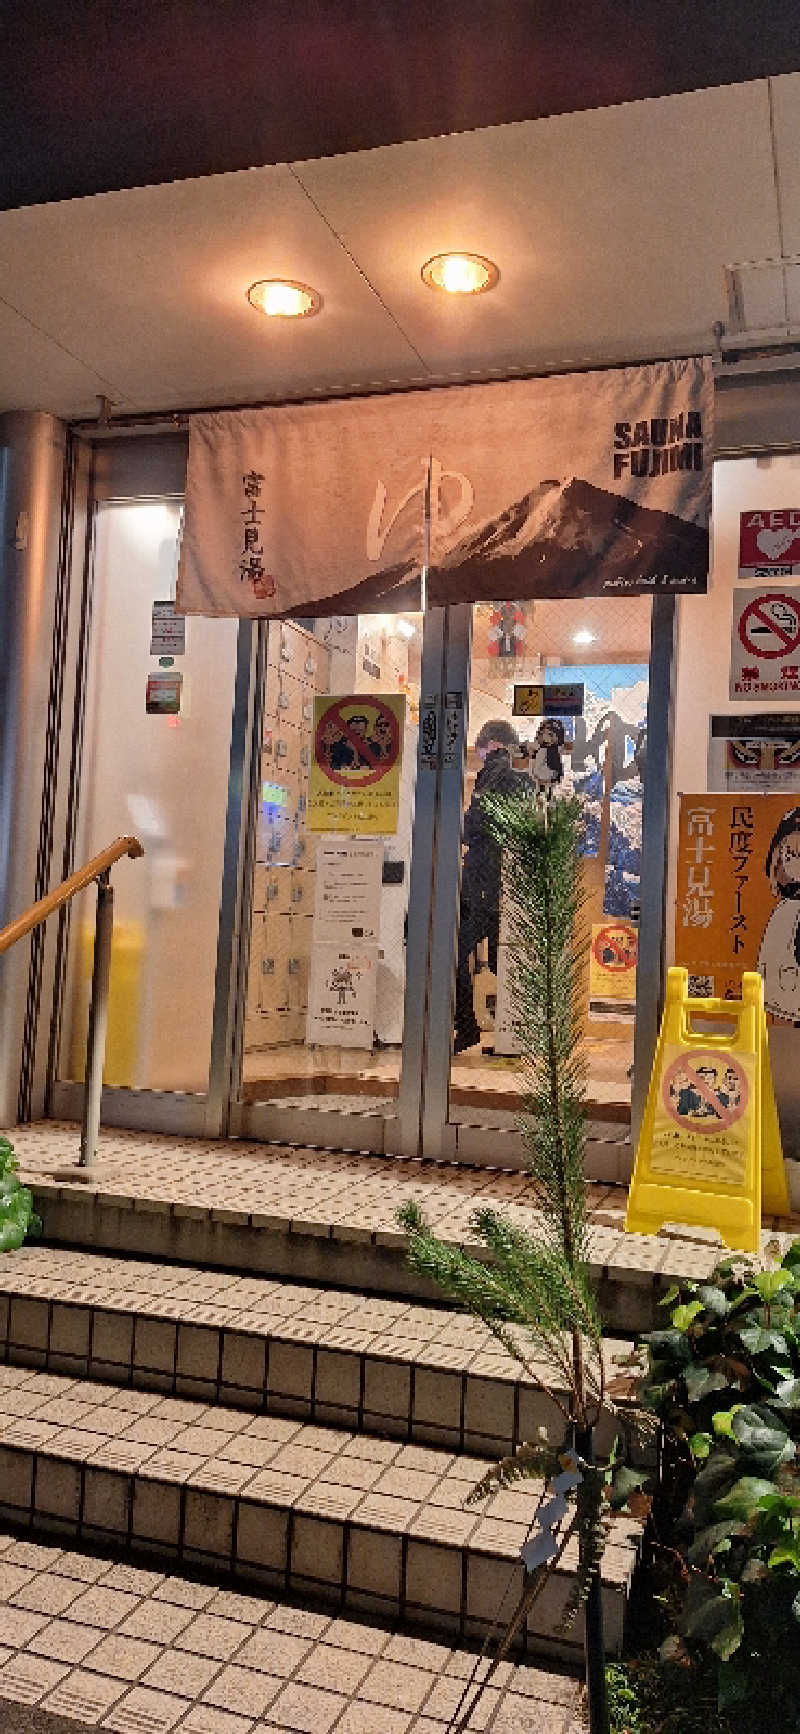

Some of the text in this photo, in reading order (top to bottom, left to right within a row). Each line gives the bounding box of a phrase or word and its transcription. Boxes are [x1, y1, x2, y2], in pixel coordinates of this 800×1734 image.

[613, 411, 703, 449] SAUNA
[613, 442, 704, 481] FUJIMI
[239, 470, 266, 584] 富士見湯
[366, 456, 475, 562] ゆ
[745, 511, 800, 528] AED
[682, 807, 716, 928] 富士見湯
[729, 806, 753, 954] 民度ファースト
